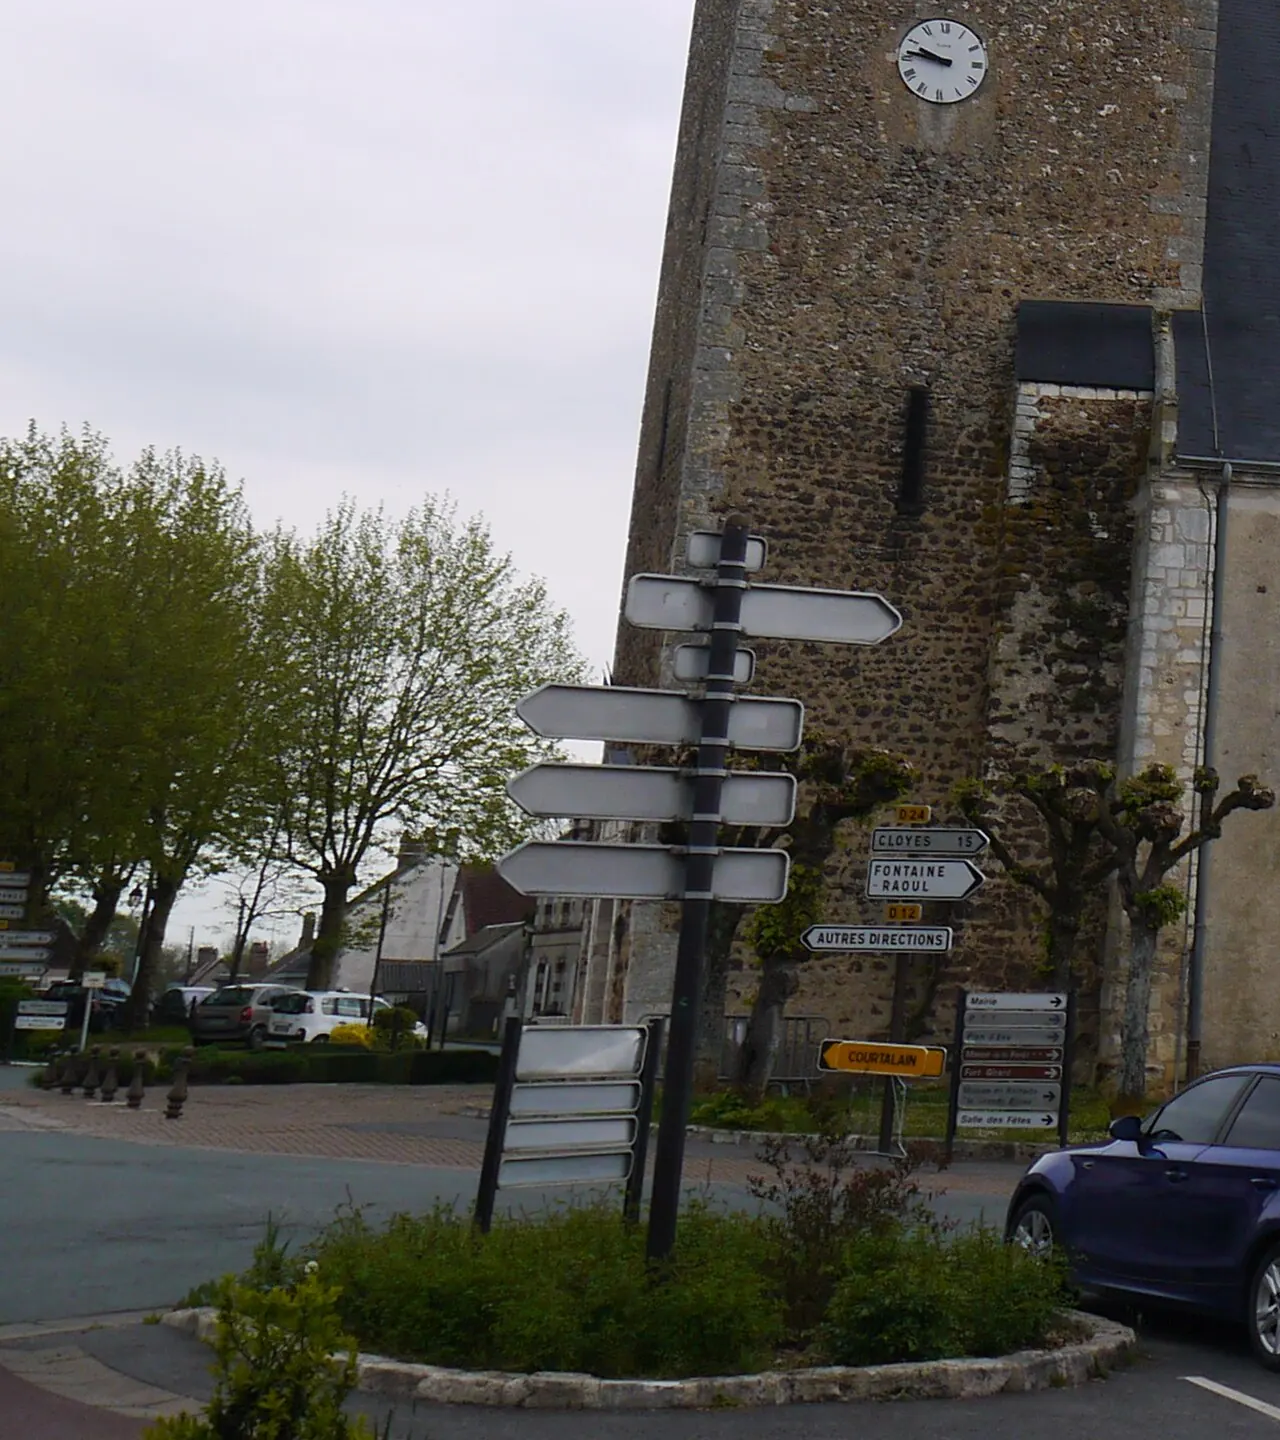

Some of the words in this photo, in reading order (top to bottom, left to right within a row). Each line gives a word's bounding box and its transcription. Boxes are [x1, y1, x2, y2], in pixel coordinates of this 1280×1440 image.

[910, 809, 925, 820] 24
[878, 834, 931, 847] CLOYES
[957, 836, 973, 847] 15
[874, 864, 946, 878] FONTAINE
[889, 908, 897, 919] D
[901, 908, 916, 919] 12
[816, 932, 866, 945] AUTRES
[869, 932, 943, 946] DIRECTIONS
[970, 997, 998, 1006] Mairie
[848, 1051, 918, 1067] COURTALAIN
[961, 1114, 983, 1124] Salle
[986, 1115, 1003, 1124] des
